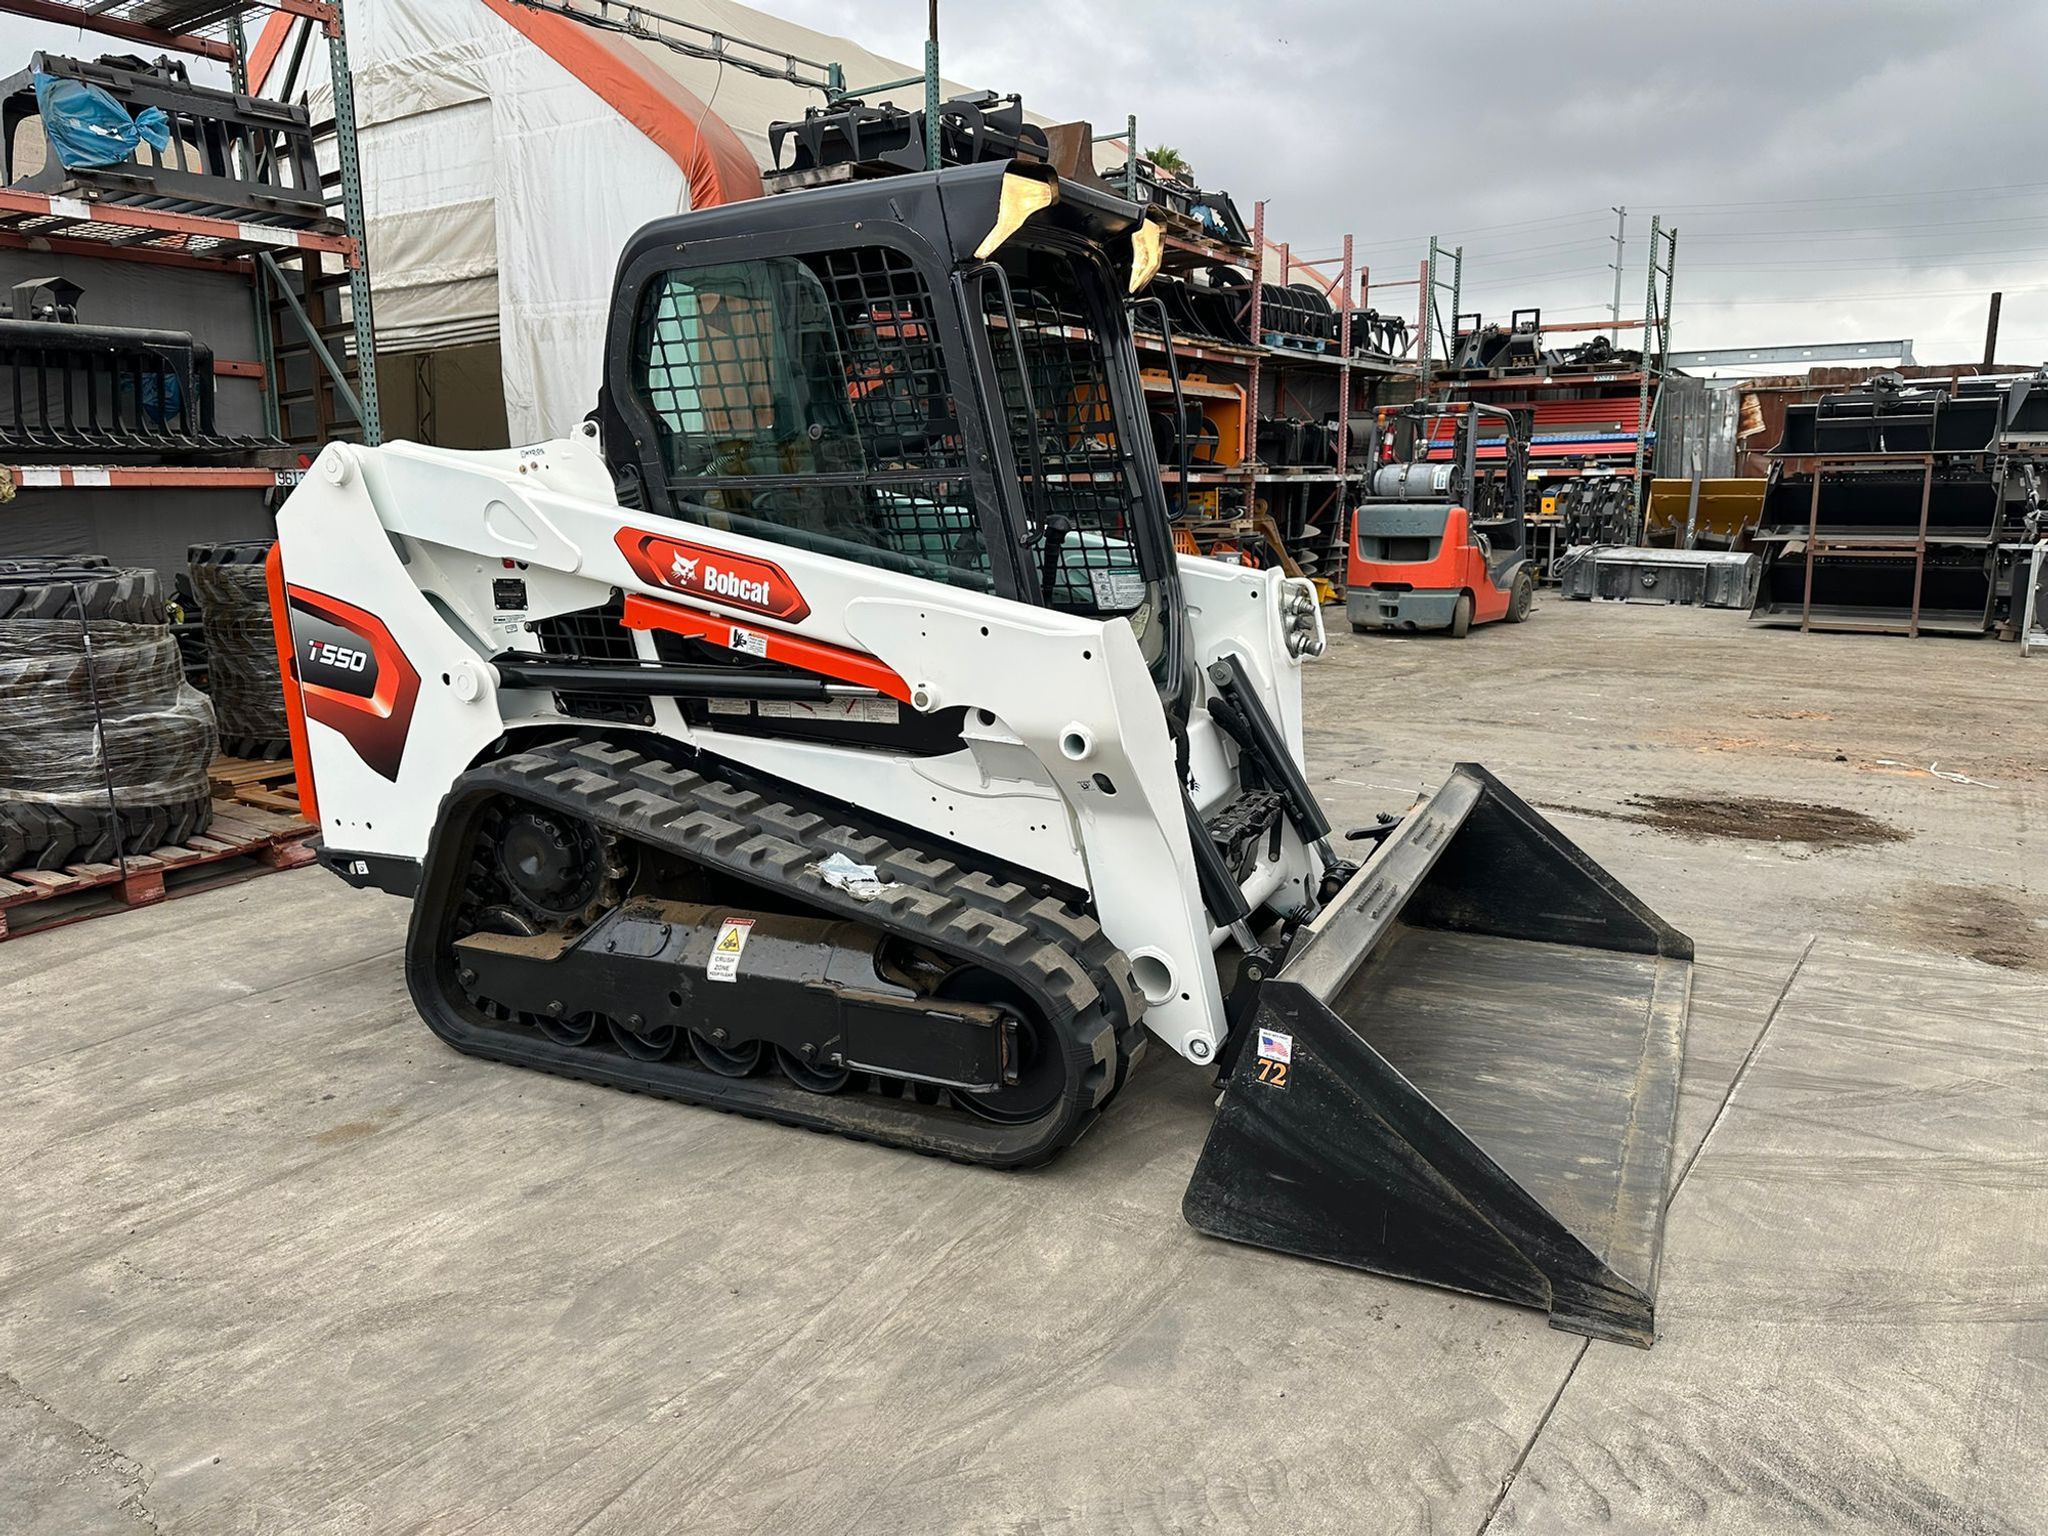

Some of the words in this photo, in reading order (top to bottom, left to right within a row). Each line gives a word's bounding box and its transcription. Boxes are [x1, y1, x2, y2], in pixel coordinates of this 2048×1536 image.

[703, 565, 770, 606] Bobcat
[308, 640, 367, 672] T550
[1258, 1058, 1287, 1086] 72
